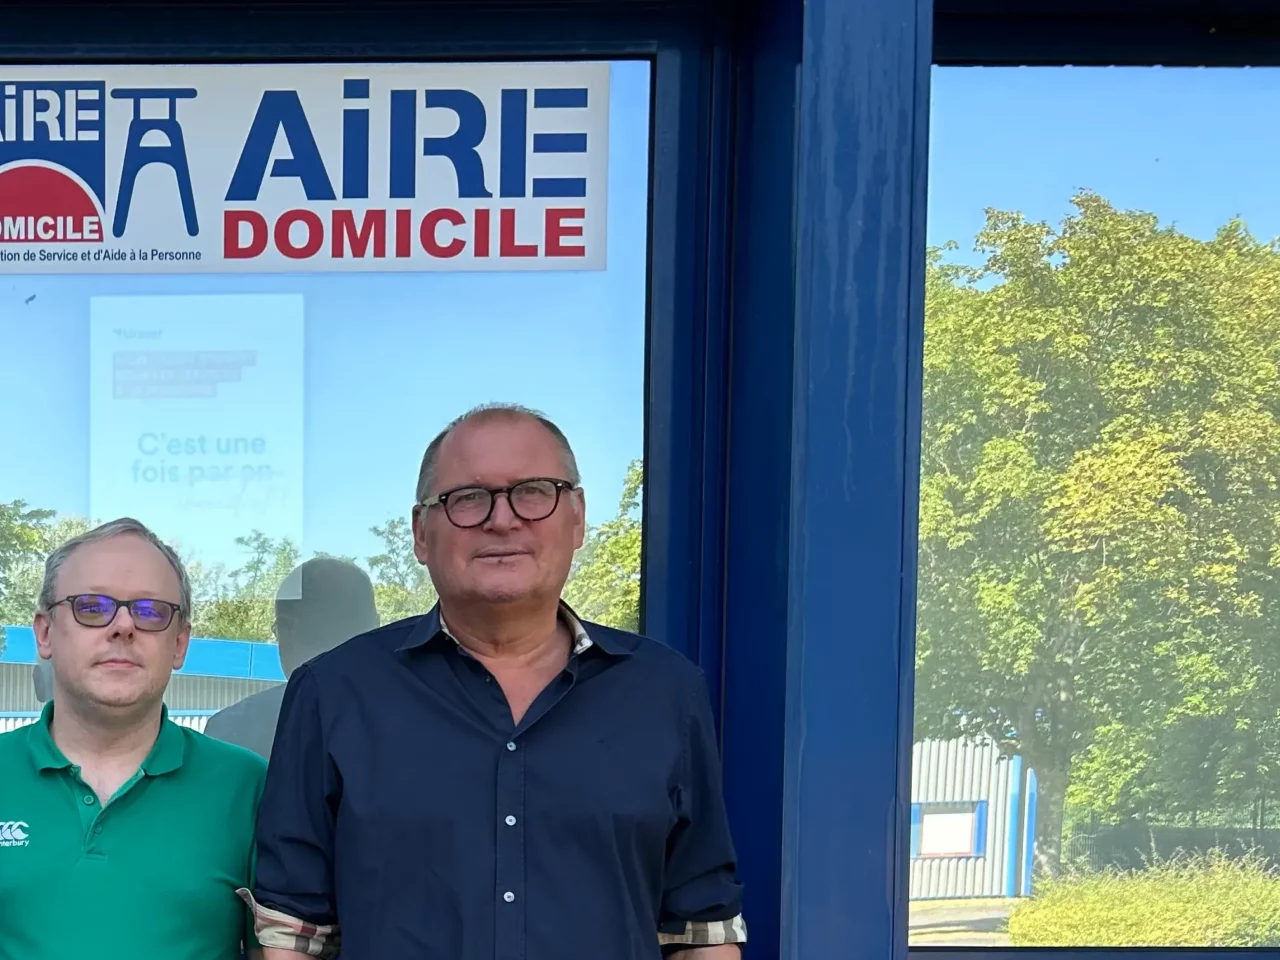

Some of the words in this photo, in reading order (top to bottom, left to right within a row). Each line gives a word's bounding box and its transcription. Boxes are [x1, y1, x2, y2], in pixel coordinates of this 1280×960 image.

[222, 207, 587, 260] DOMICILE
[23, 250, 36, 262] de
[39, 250, 78, 261] Service
[81, 250, 91, 261] et
[94, 249, 127, 261] d'Aide
[130, 249, 136, 260] à
[139, 249, 148, 260] la
[151, 249, 201, 261] Personne
[137, 432, 207, 456] C'est
[216, 436, 267, 455] une
[131, 459, 180, 483] fois
